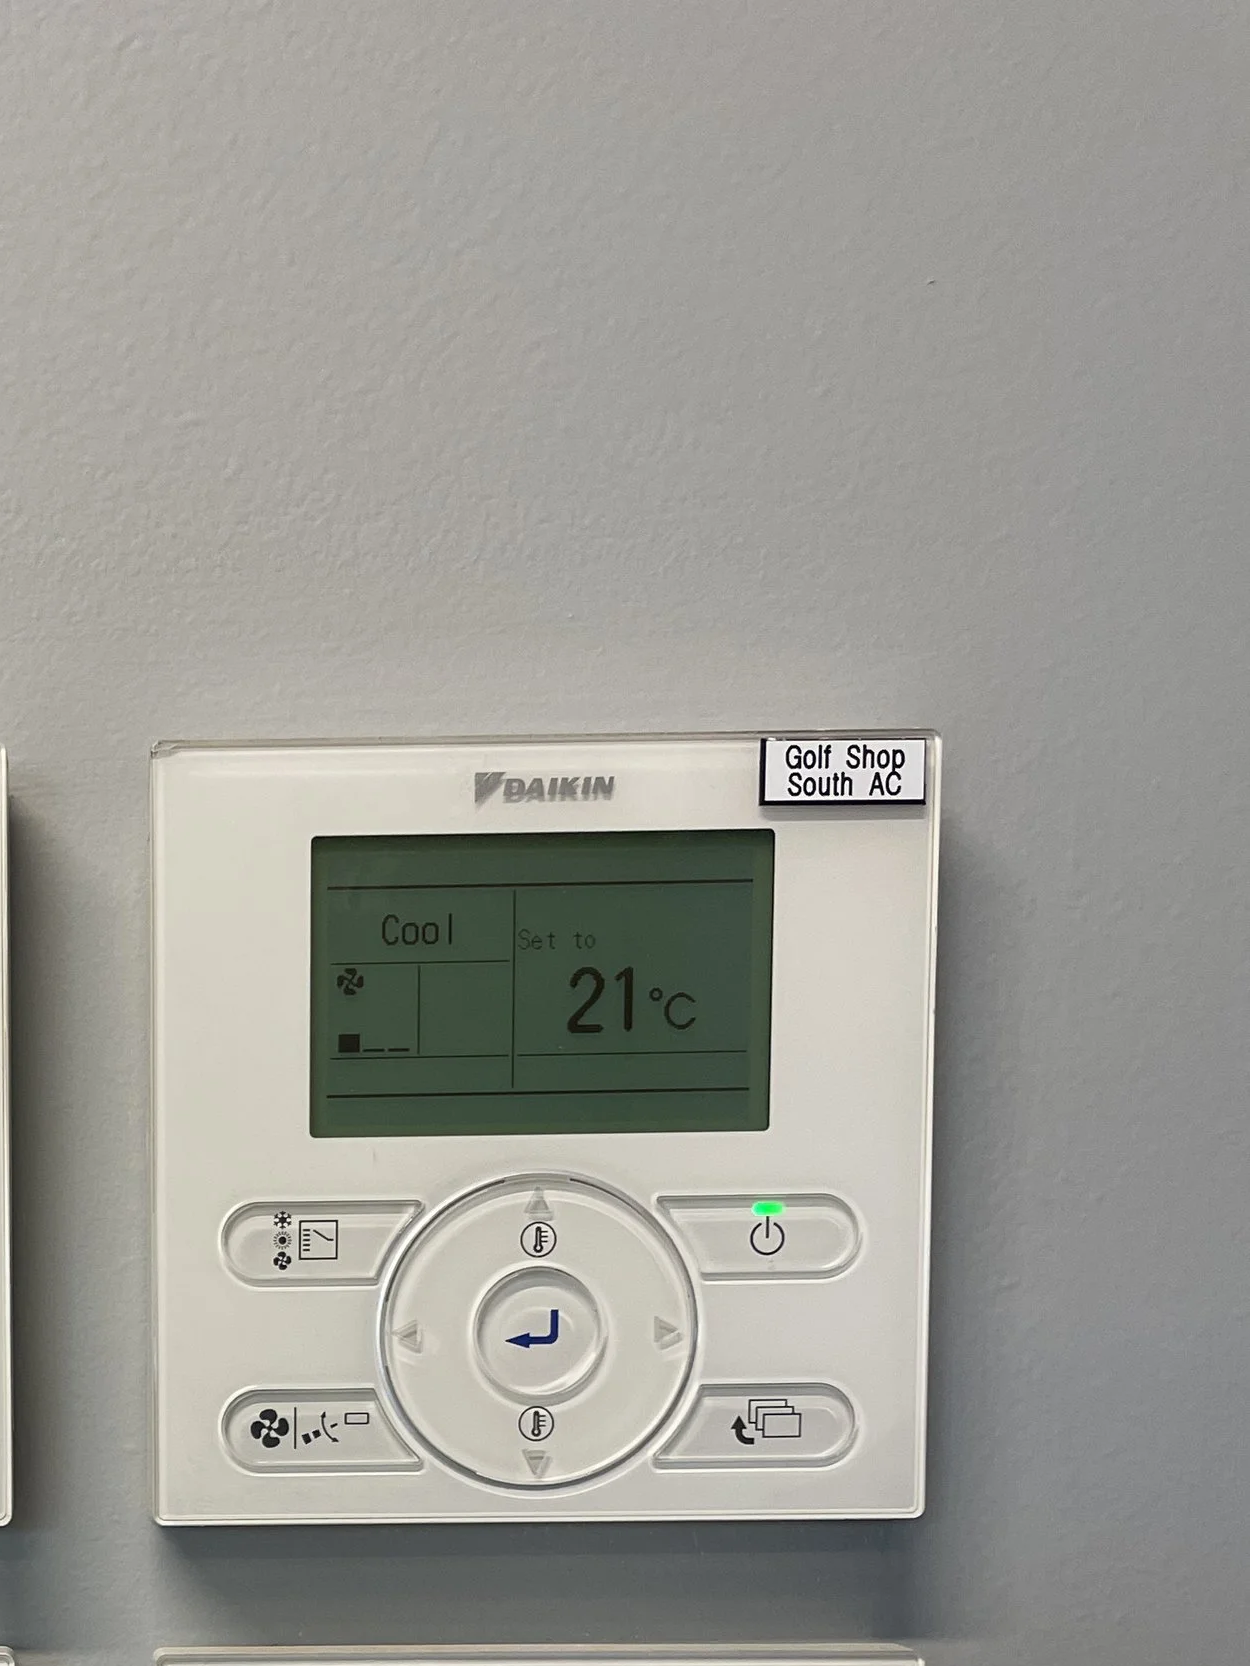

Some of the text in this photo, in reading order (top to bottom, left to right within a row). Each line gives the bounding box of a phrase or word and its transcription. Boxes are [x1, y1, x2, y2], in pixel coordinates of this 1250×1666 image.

[785, 745, 906, 778] Golf Shop
[503, 775, 615, 803] DAIKIN
[787, 772, 903, 798] South AC
[381, 914, 454, 947] Cool
[518, 929, 596, 951] Set to
